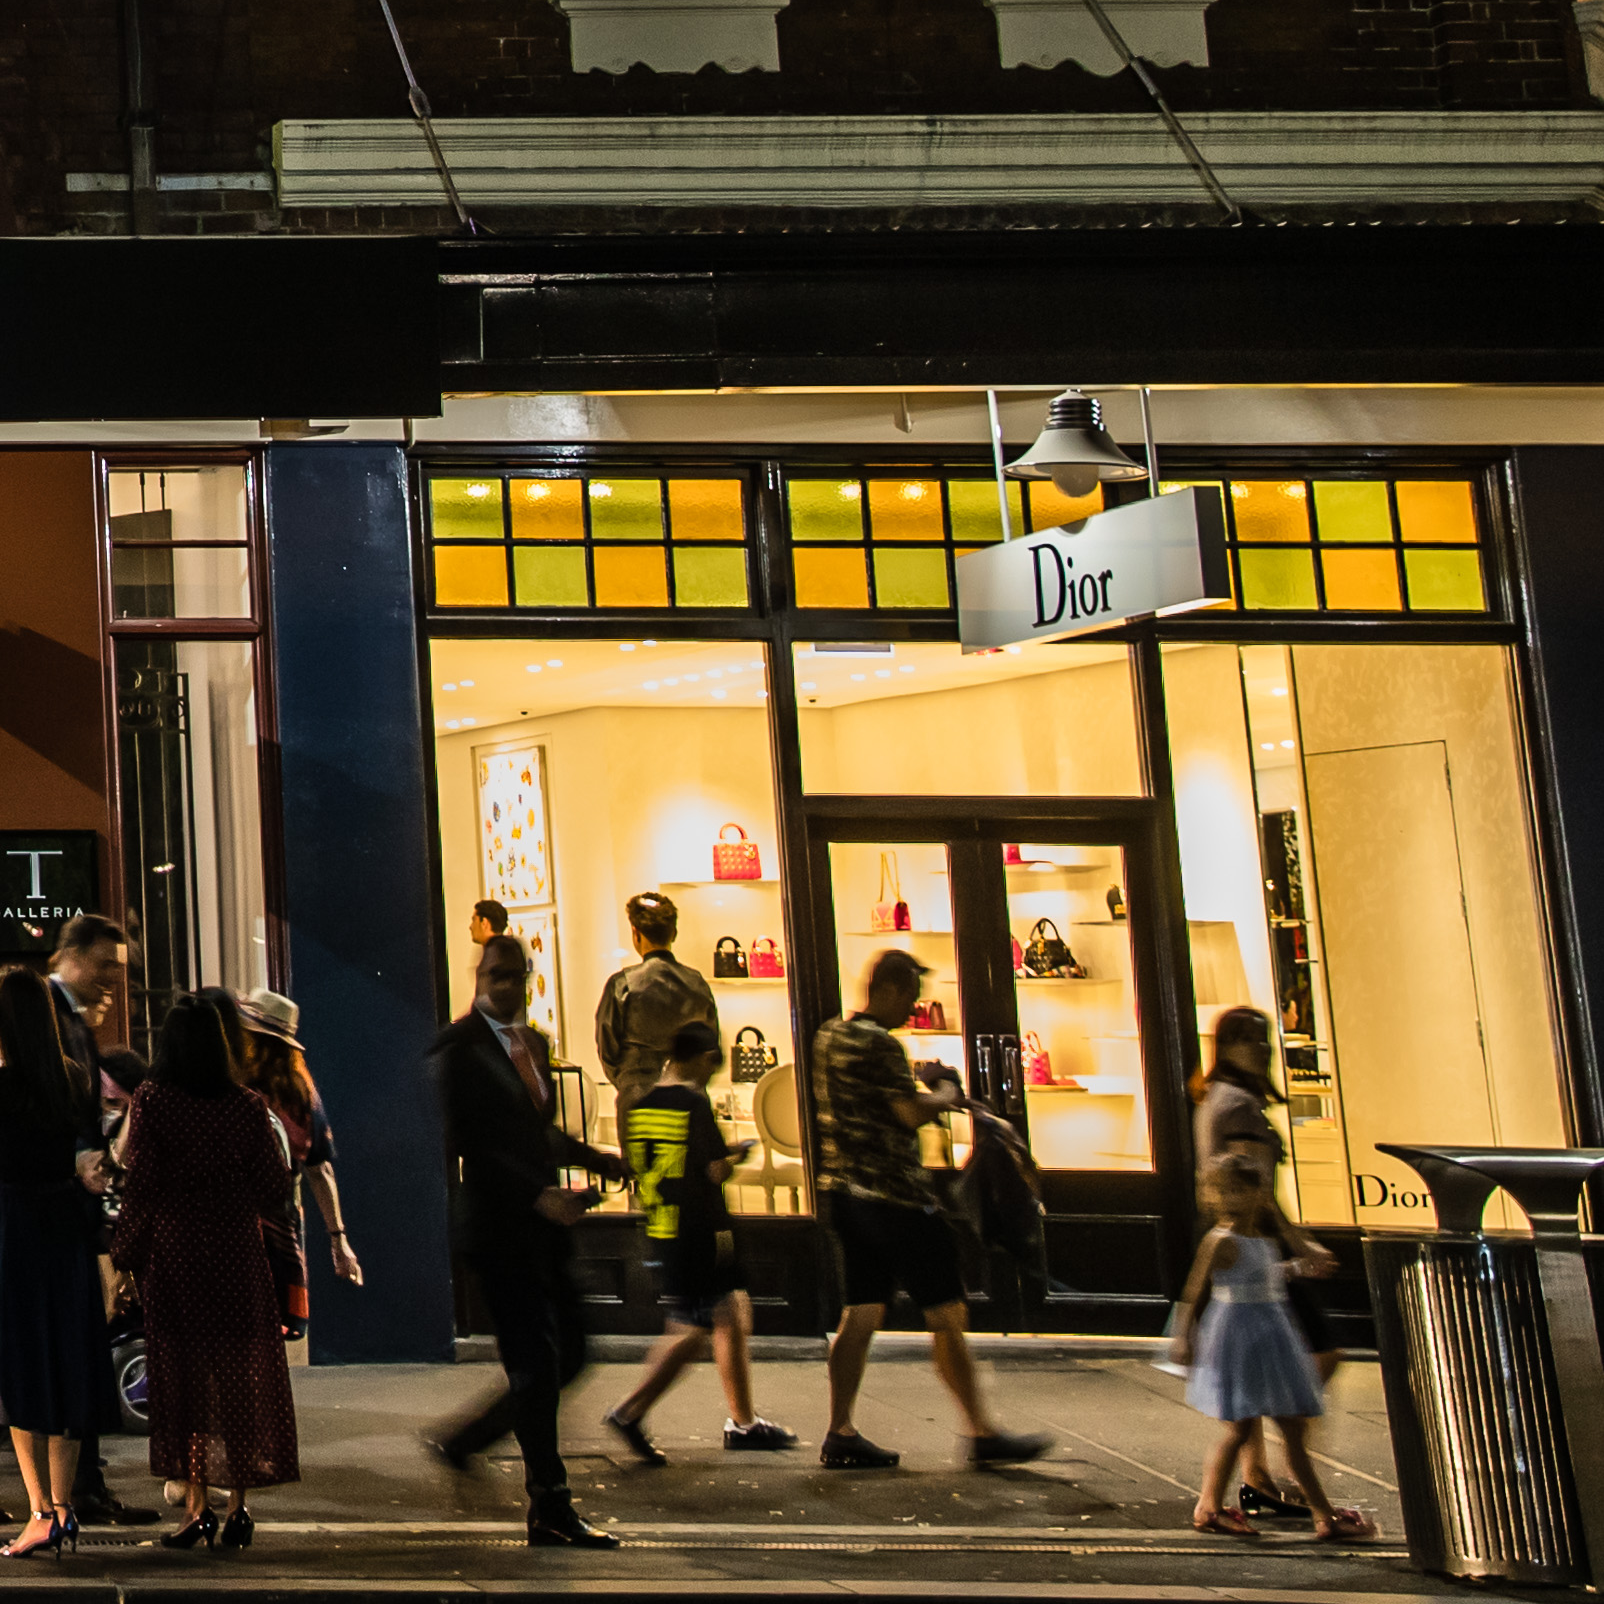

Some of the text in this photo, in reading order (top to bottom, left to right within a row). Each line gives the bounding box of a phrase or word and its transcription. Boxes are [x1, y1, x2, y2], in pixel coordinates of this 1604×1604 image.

[1027, 542, 1114, 629] Dior
[6, 850, 63, 899] T
[1352, 1173, 1433, 1208] Dior
